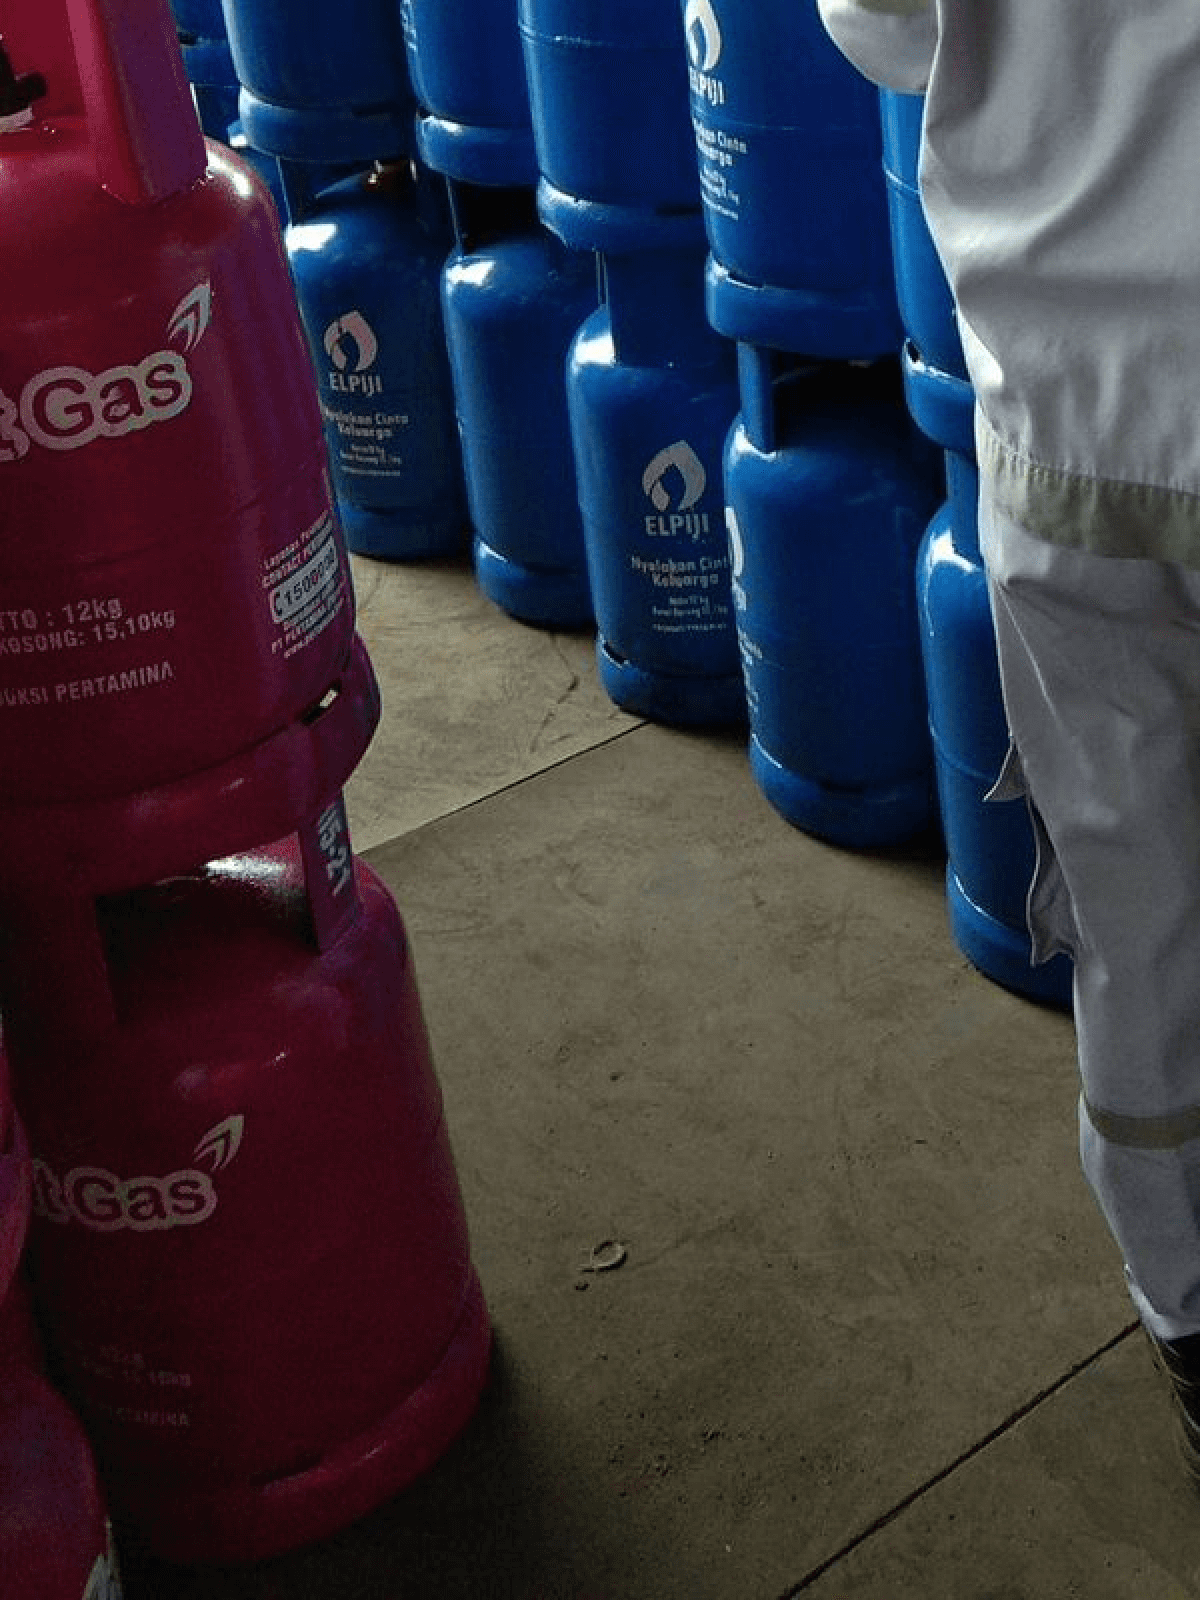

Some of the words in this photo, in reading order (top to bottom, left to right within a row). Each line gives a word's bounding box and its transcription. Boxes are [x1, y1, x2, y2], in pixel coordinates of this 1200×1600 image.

[329, 371, 383, 398] ELPIJI
[645, 512, 709, 541] ELPIJI
[54, 659, 175, 703] PERTAMINA
